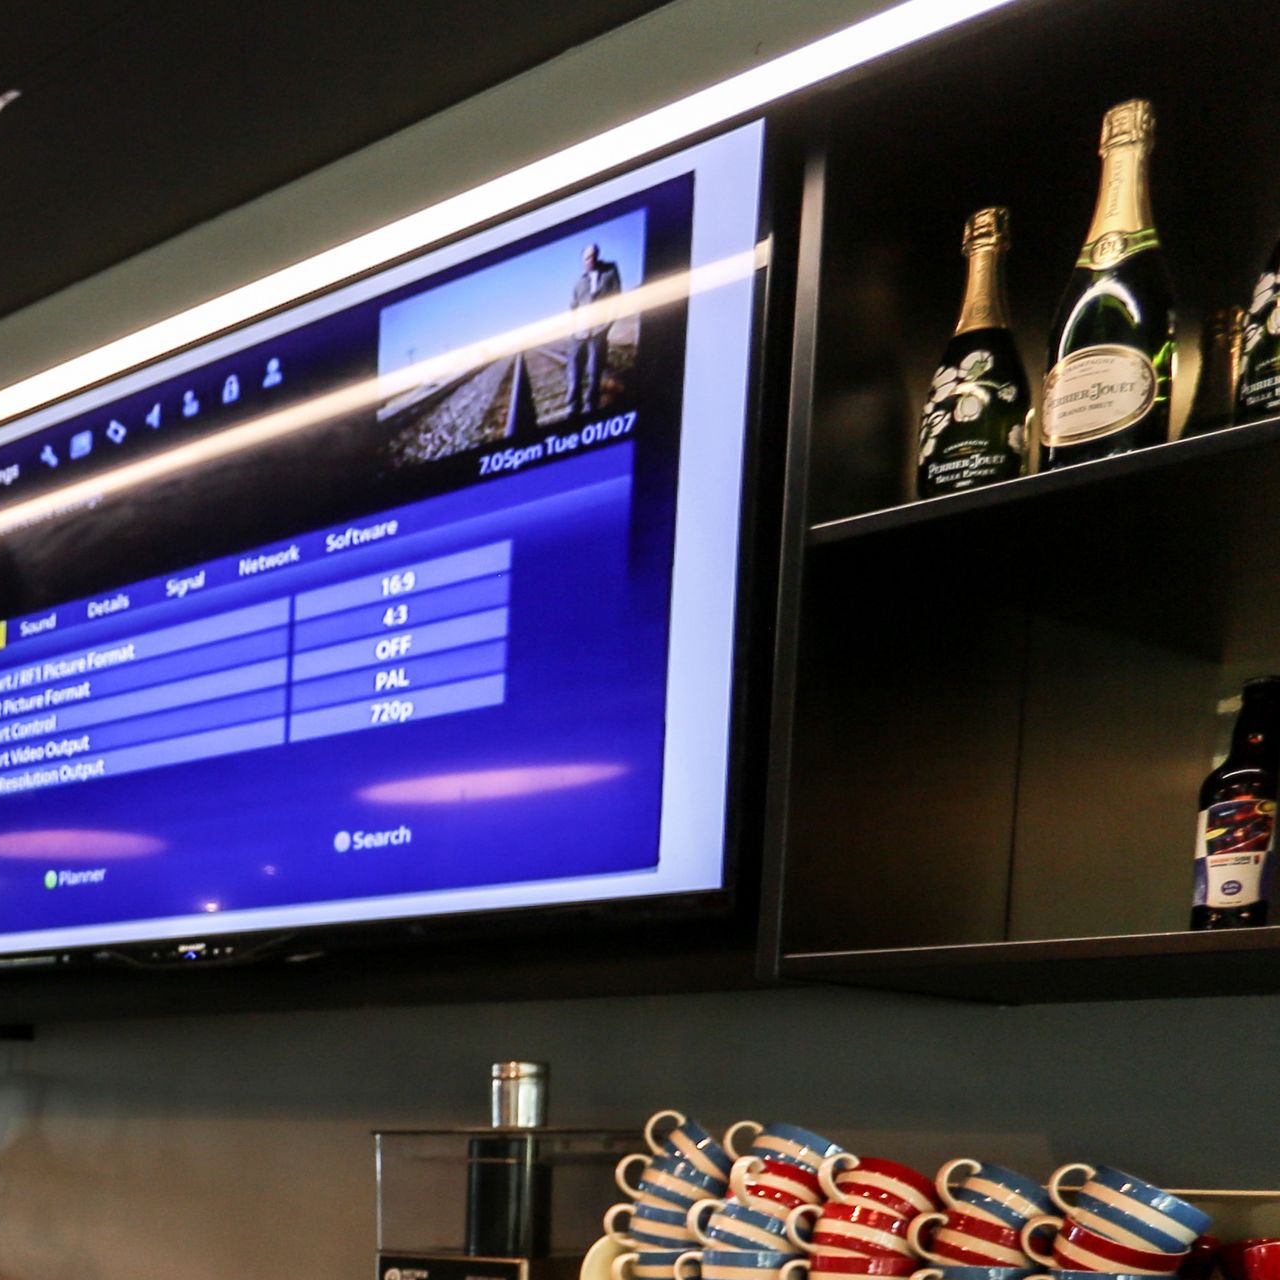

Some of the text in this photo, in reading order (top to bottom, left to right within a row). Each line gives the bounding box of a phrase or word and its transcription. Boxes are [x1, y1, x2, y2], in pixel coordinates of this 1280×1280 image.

[545, 434, 579, 455] Tue
[581, 411, 637, 445] 01/07
[325, 520, 398, 552] Software
[239, 545, 300, 576] Network
[165, 570, 206, 598] Signal
[87, 593, 130, 619] Details
[20, 613, 57, 637] Sound
[375, 634, 412, 661] OFF
[42, 657, 86, 680] Picture
[87, 643, 134, 670] Format
[375, 668, 409, 692] PAL
[3, 694, 44, 715] Picture
[45, 681, 90, 706] Format
[370, 700, 414, 723] 720p
[10, 714, 56, 738] Control
[10, 746, 44, 765] Video
[44, 735, 90, 758] Output
[59, 758, 104, 782] Output
[352, 825, 412, 850] Search
[58, 868, 107, 887] Planner
